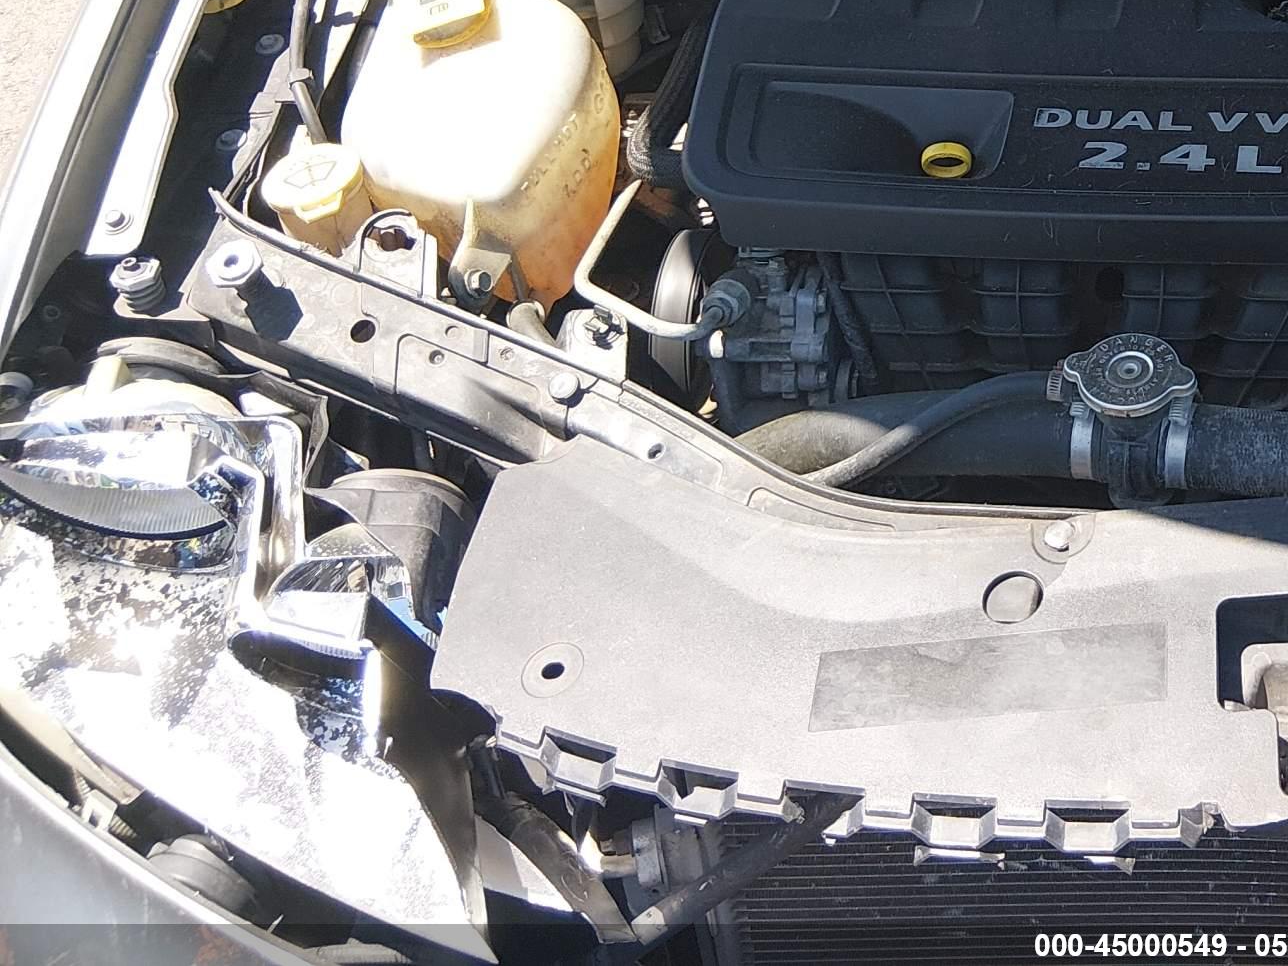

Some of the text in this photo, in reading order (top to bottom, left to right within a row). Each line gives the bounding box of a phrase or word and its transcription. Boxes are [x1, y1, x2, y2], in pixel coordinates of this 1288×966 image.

[1032, 107, 1193, 132] DUAL
[1078, 141, 1282, 174] 2.4L
[1099, 336, 1175, 362] DANGER
